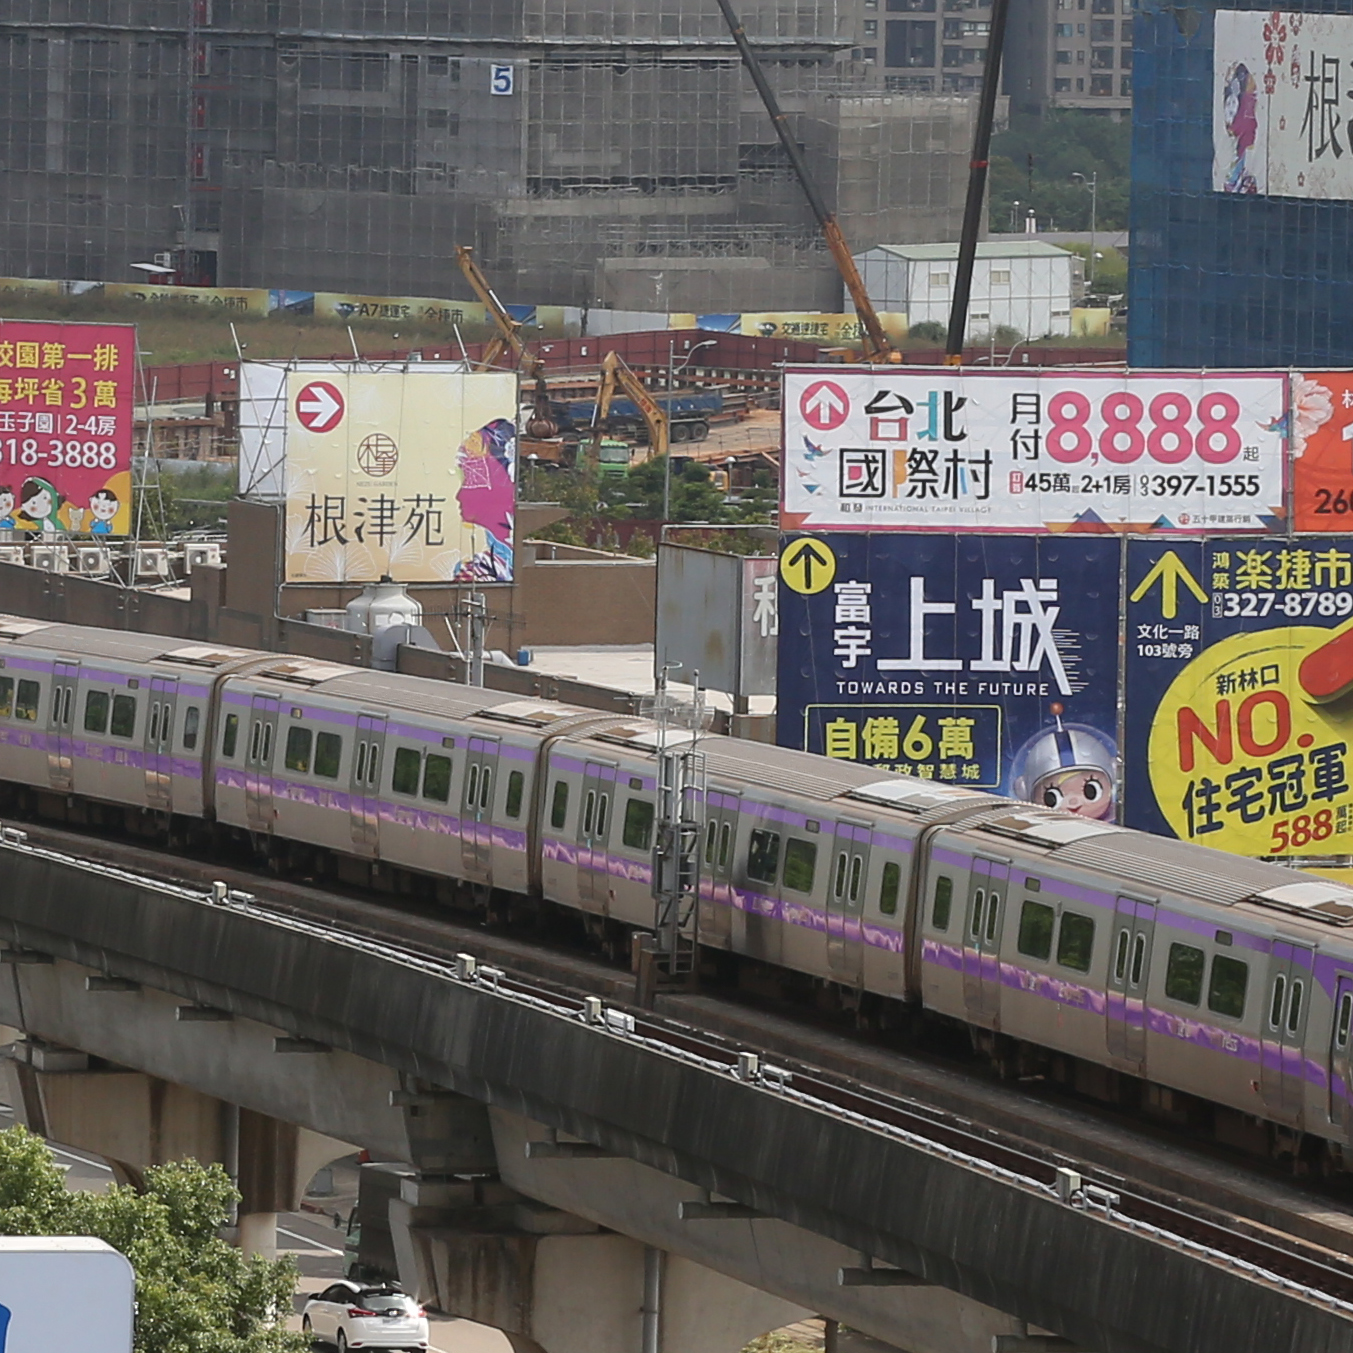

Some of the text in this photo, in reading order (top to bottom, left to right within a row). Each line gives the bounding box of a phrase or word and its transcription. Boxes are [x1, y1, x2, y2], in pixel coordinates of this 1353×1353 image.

[492, 66, 511, 93] 5
[65, 414, 116, 436] 2-4房
[864, 389, 968, 442] 台北
[1010, 393, 1042, 461] 月付
[1046, 391, 1261, 467] 8,888 起
[838, 447, 993, 500] 國際村
[1151, 475, 1260, 497] 397-1555
[302, 493, 447, 547] 根津苑
[865, 505, 928, 513] INTERNATIONAL
[1211, 552, 1231, 589] 鴻築
[833, 580, 872, 668] 富宇
[1224, 592, 1353, 617] 327-8789
[877, 576, 1073, 696] 上城
[1137, 624, 1200, 640] 文化一路
[1137, 643, 1193, 659] 103號旁
[836, 681, 1050, 696] TOWARDS THE FUTURE
[1216, 664, 1280, 696] 新林口
[825, 714, 976, 760] 自備6萬
[1177, 690, 1315, 772] NO.
[1182, 742, 1350, 838] 住宅冠軍
[1269, 809, 1333, 854] 588
